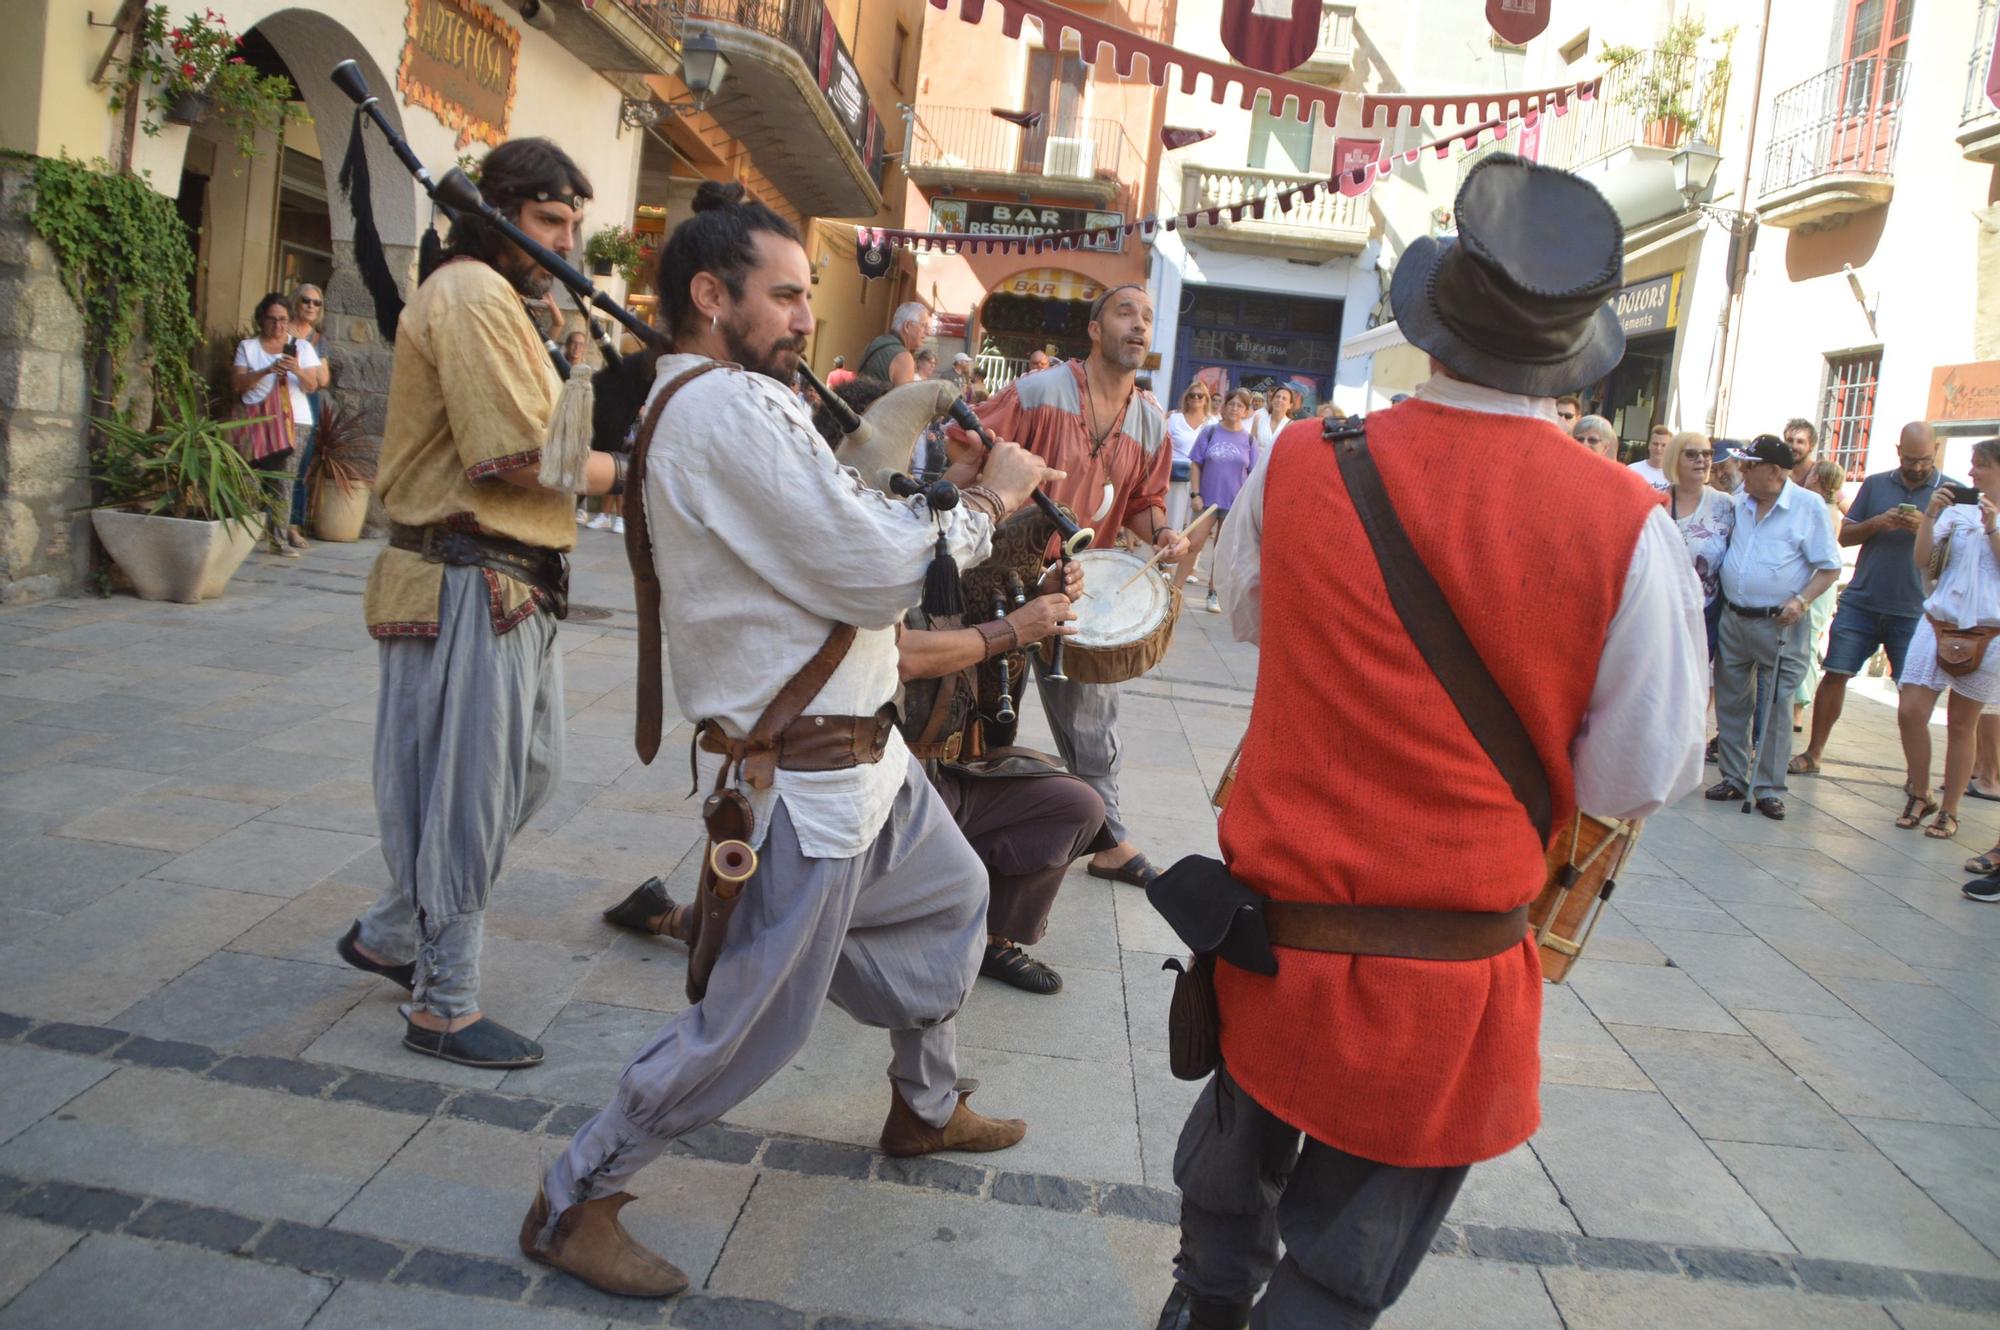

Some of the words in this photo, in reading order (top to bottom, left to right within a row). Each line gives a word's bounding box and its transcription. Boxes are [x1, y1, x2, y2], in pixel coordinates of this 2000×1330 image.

[992, 205, 1061, 225] BAR
[1013, 280, 1057, 295] BAR
[1616, 283, 1667, 316] DOLORS
[1621, 314, 1653, 331] lements
